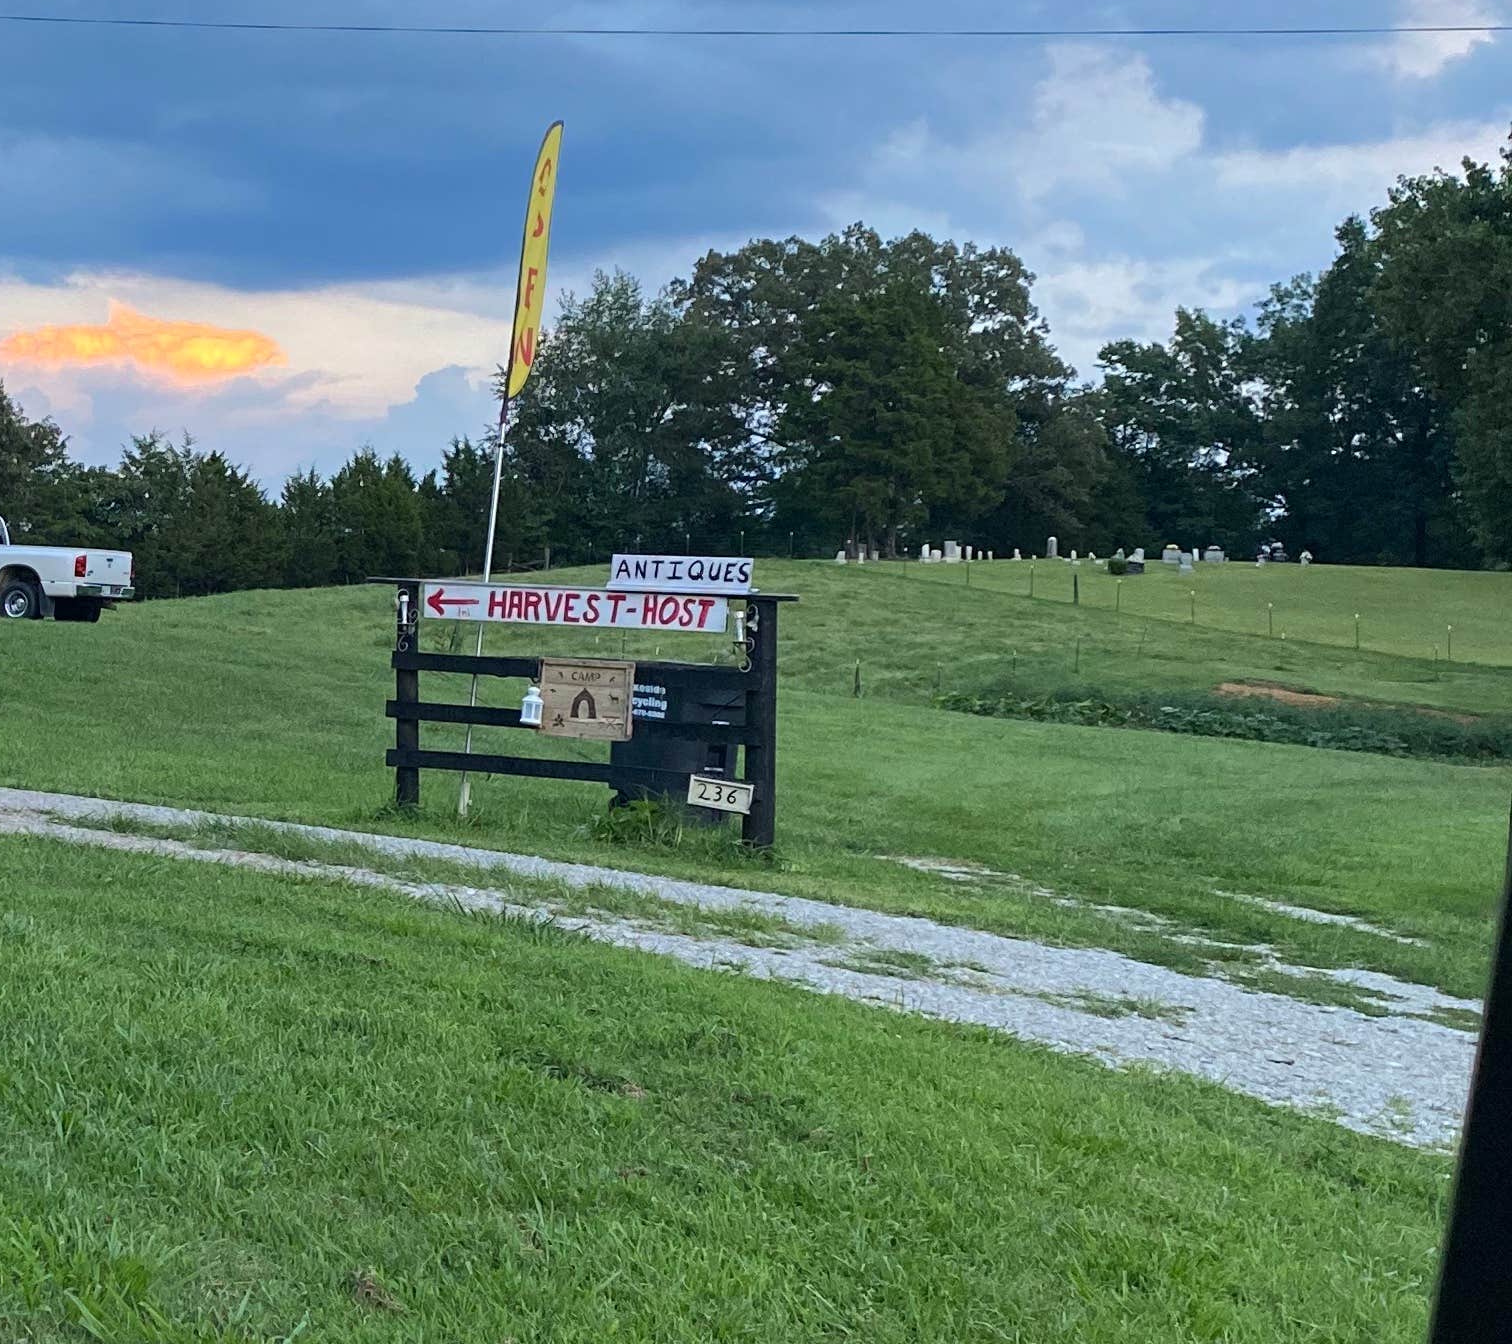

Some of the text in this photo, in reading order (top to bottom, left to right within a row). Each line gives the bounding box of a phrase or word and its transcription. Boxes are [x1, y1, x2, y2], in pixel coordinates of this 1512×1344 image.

[615, 559, 751, 583] ANTIQUES
[571, 671, 601, 682] CAMP
[632, 697, 668, 711] cycling
[697, 783, 739, 804] 236
